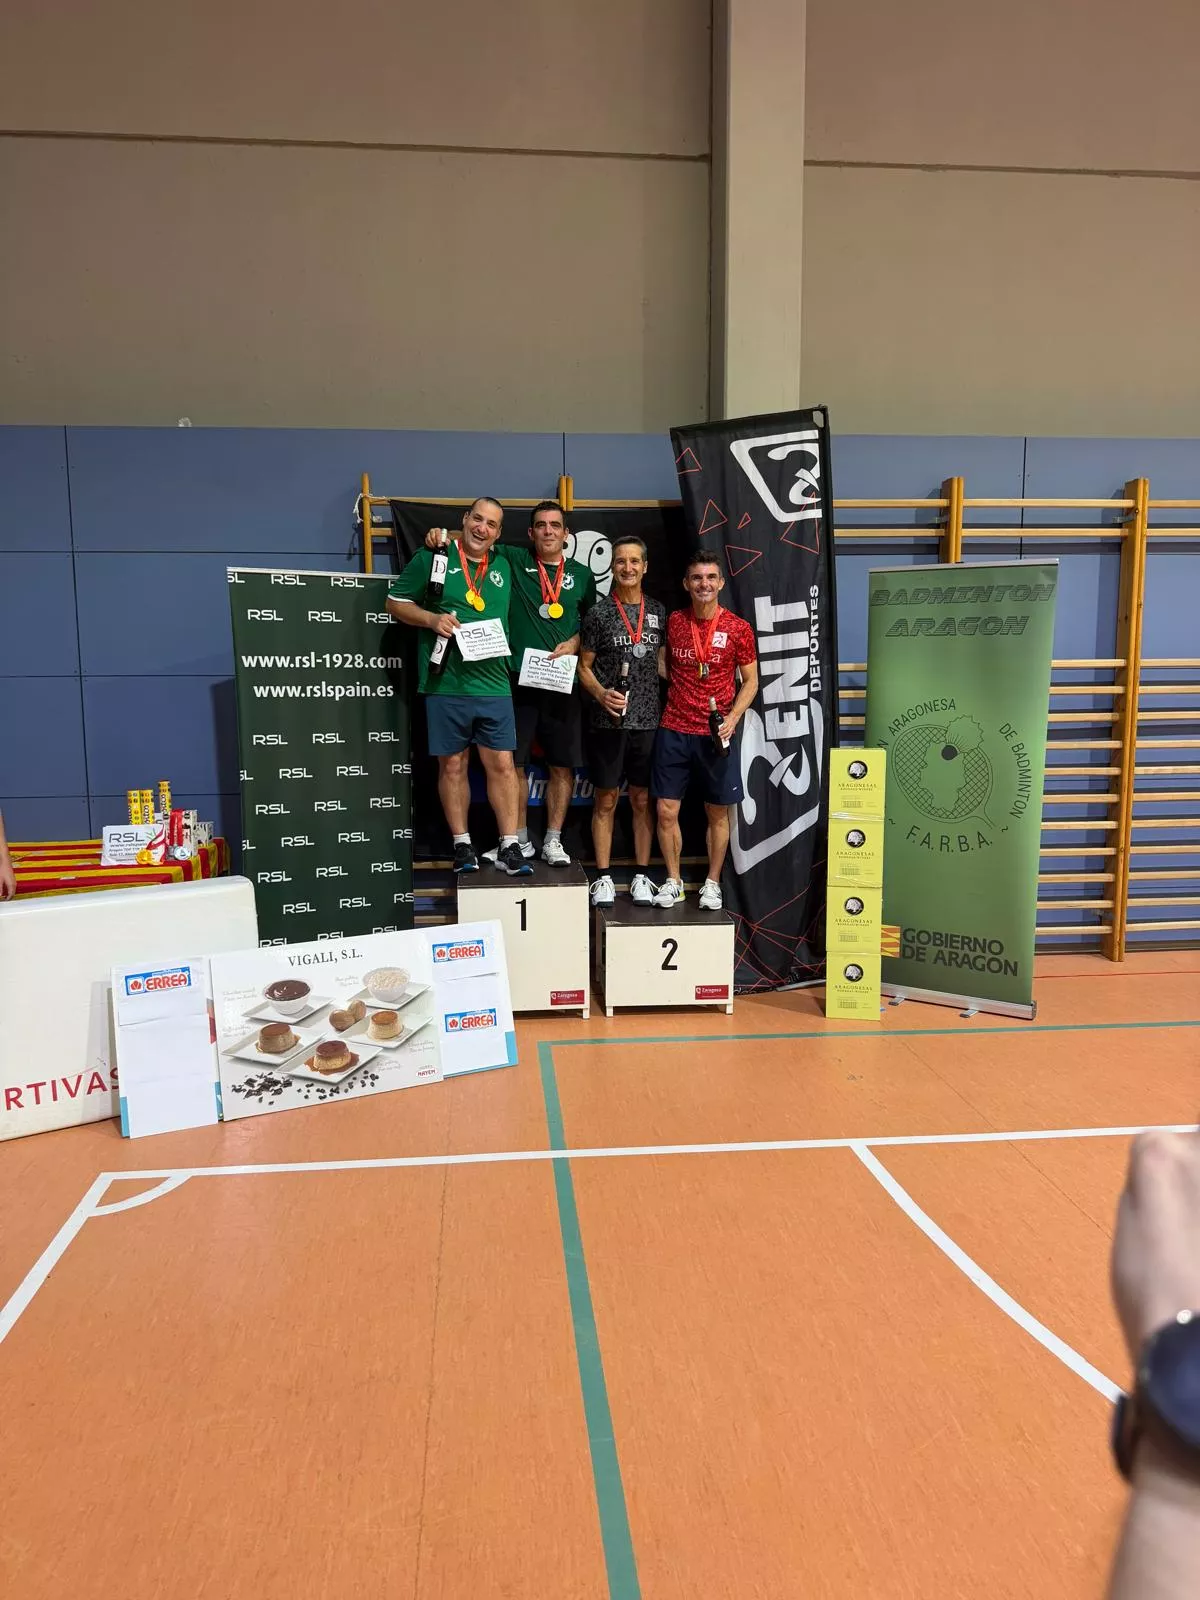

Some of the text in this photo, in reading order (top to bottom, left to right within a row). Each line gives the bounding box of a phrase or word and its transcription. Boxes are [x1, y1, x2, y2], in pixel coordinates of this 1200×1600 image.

[271, 574, 306, 585] RSL
[331, 576, 364, 588] RSL
[871, 583, 1055, 606] BADMINTON
[247, 609, 397, 624] RSL RSL RSL
[460, 627, 492, 640] RSL
[885, 616, 1030, 637] ARAGON
[809, 584, 821, 691] DEPORTES
[242, 652, 403, 668] www.rsl-1928.com
[529, 656, 559, 669] RSL
[253, 682, 394, 701] www.rslspain.es
[888, 698, 956, 736] ARAGONESA
[253, 732, 400, 746] RSL RSL RSL
[279, 768, 313, 779] RSL
[336, 766, 369, 777] RSL
[999, 723, 1032, 819] DE BADMINTON
[255, 797, 401, 815] RSL RSL RSL
[109, 832, 145, 843] RSL
[281, 835, 315, 847] RSL
[338, 832, 370, 843] RSL
[906, 825, 993, 853] F.A.R.B.A.
[257, 861, 402, 884] RSL RSL RSL
[283, 903, 316, 915] RSL
[339, 897, 371, 909] RSL
[515, 898, 527, 931] 1
[902, 928, 1004, 956] GOBIERNO
[288, 949, 363, 967] VIGALI, S.L.
[449, 945, 481, 958] ERREA
[661, 938, 678, 971] 2
[902, 944, 1018, 977] DE ARAGON
[146, 973, 187, 990] ERREA
[461, 1014, 493, 1028] ERREA
